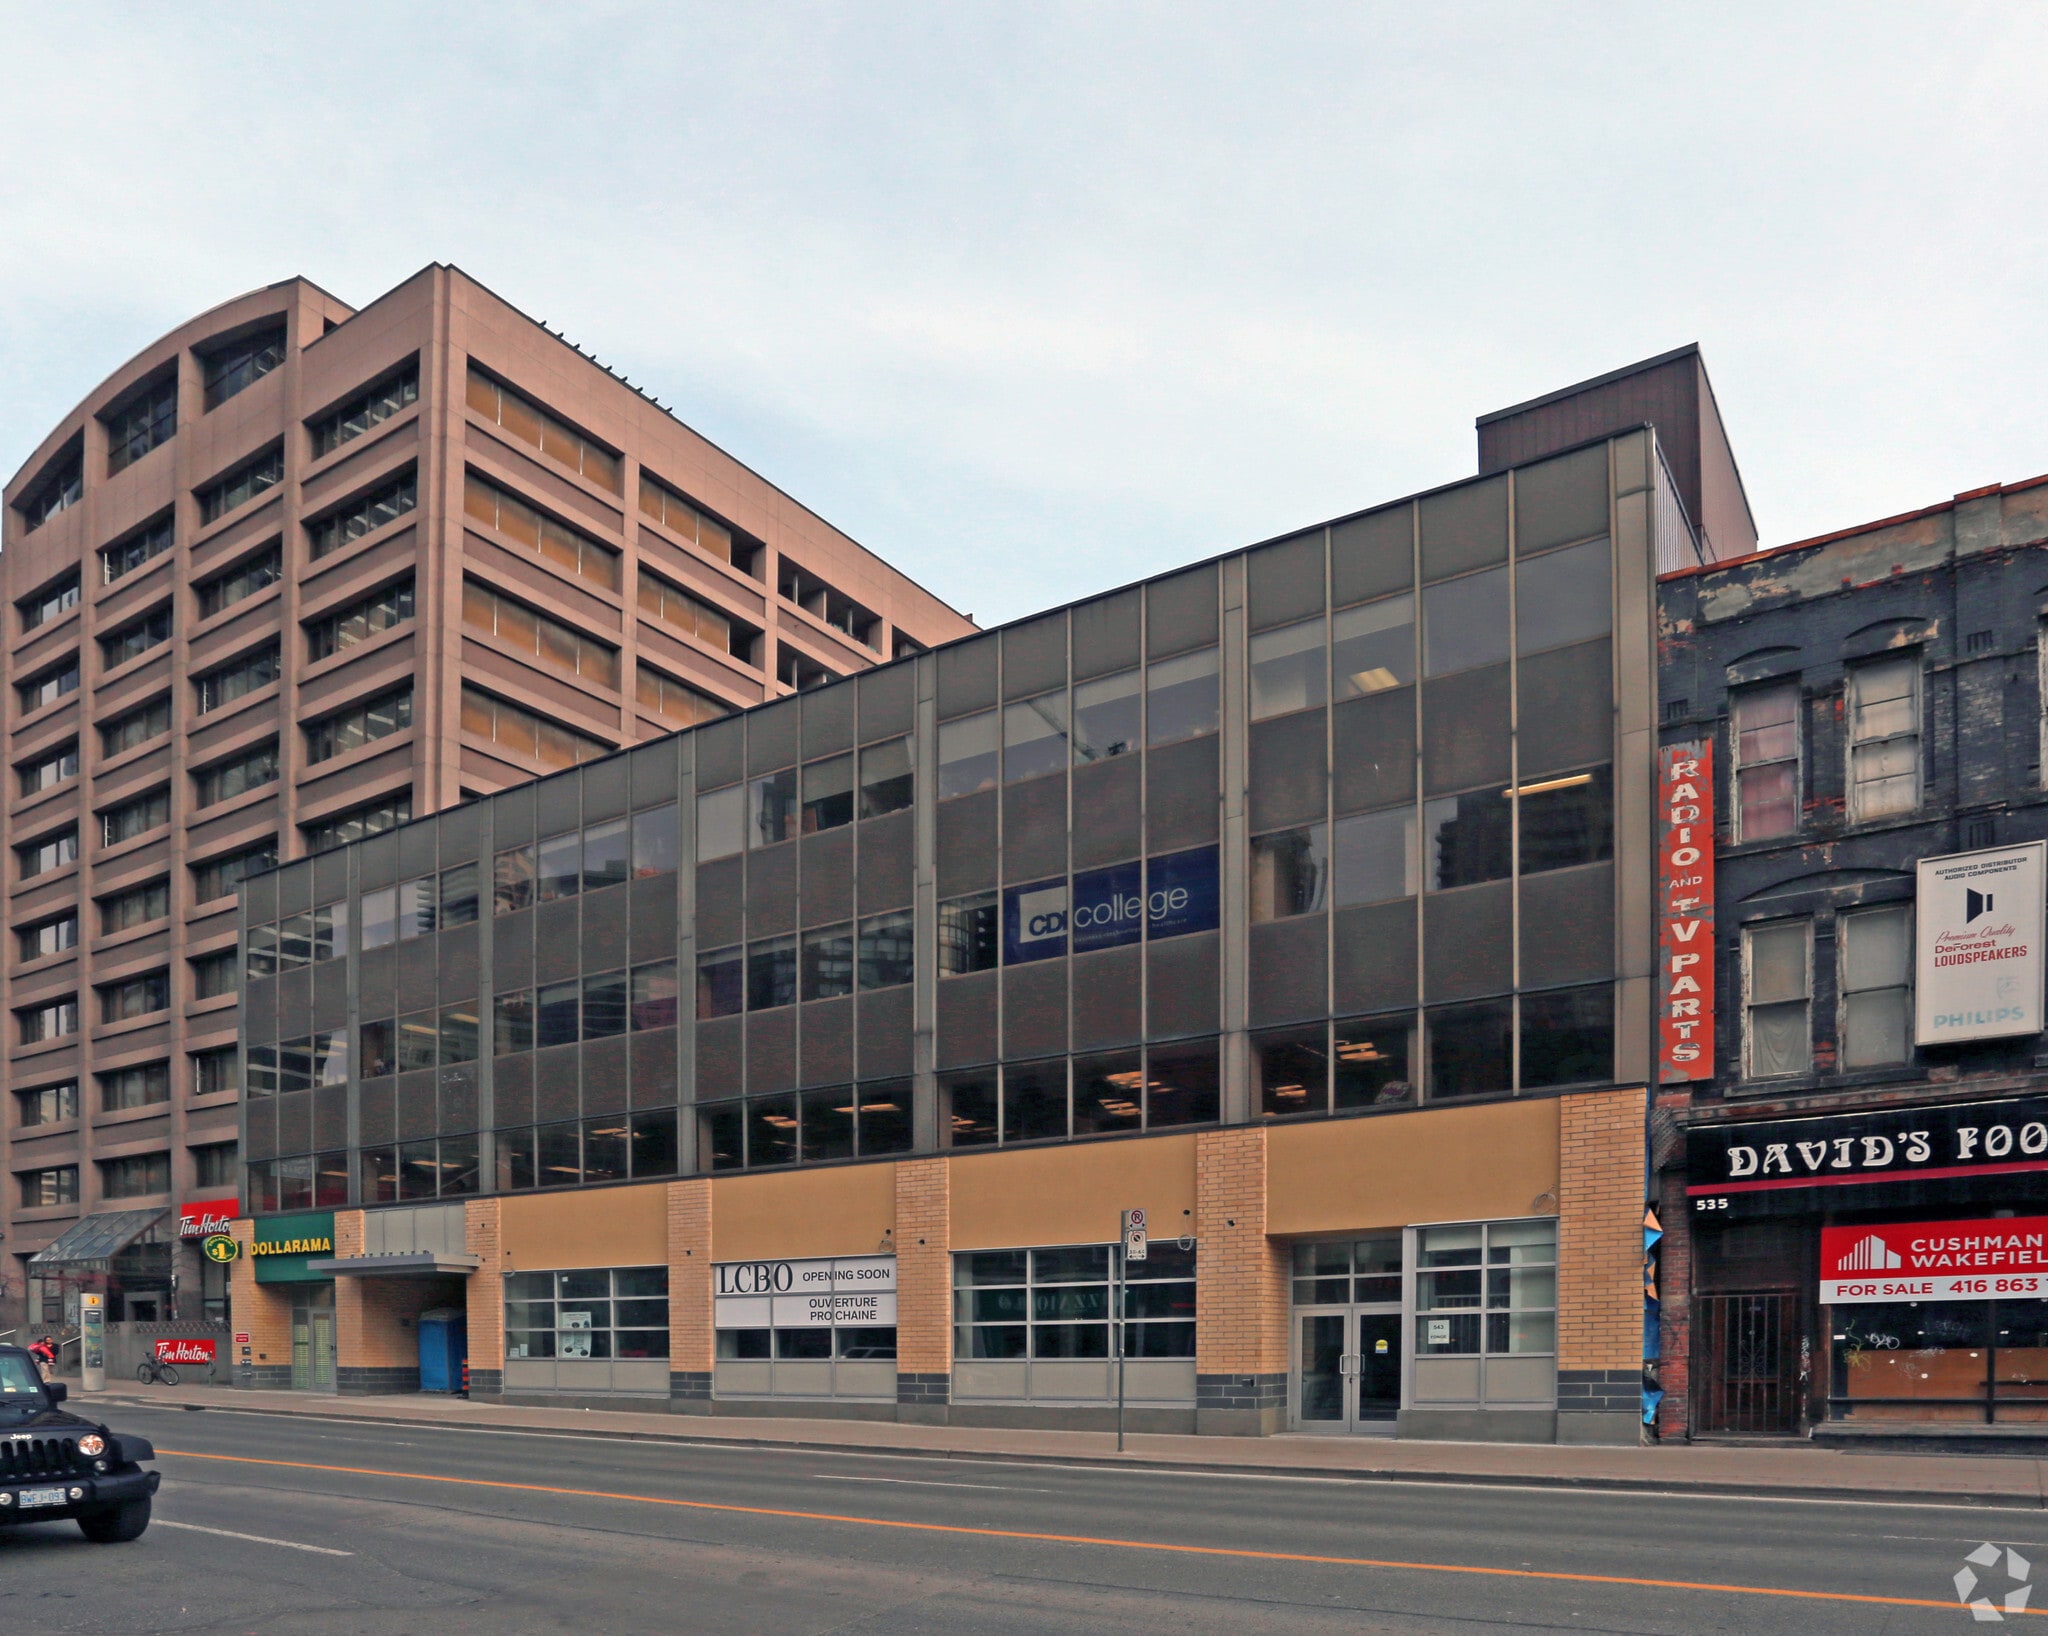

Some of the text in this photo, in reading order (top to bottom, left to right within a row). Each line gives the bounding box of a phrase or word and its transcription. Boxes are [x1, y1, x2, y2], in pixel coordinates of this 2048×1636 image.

[1671, 760, 1700, 867] RADIO
[1935, 856, 2027, 876] AUTHORIZED DISTRIBUTOR
[1944, 865, 2017, 881] AUDIO COMPONENTS
[1669, 875, 1703, 888] AND
[1074, 887, 1189, 929] college
[1936, 923, 2016, 944] Premium Quality
[1934, 945, 2028, 968] LOUDSPEAKERS
[1935, 939, 1997, 954] DeForest
[1670, 953, 1701, 1062] PARTS
[1933, 1006, 2025, 1029] PHILIPS
[1727, 1131, 1931, 1177] DAVID'S
[1696, 1198, 1729, 1211] 535
[180, 1215, 199, 1236] Tim
[212, 1243, 227, 1259] $1
[251, 1237, 331, 1256] DOLLARAMA
[1911, 1233, 2043, 1253] CUSHMAN
[719, 1262, 794, 1294] LCBO
[802, 1268, 890, 1282] OPENING SOON
[1836, 1284, 1879, 1297] FOR
[1883, 1282, 1933, 1295] SALE
[1949, 1278, 1987, 1294] 416
[1995, 1277, 2038, 1293] 863
[808, 1297, 878, 1309] OUVERTURE
[810, 1310, 877, 1321] PROCHAINE
[157, 1341, 212, 1361] Tim Horton
